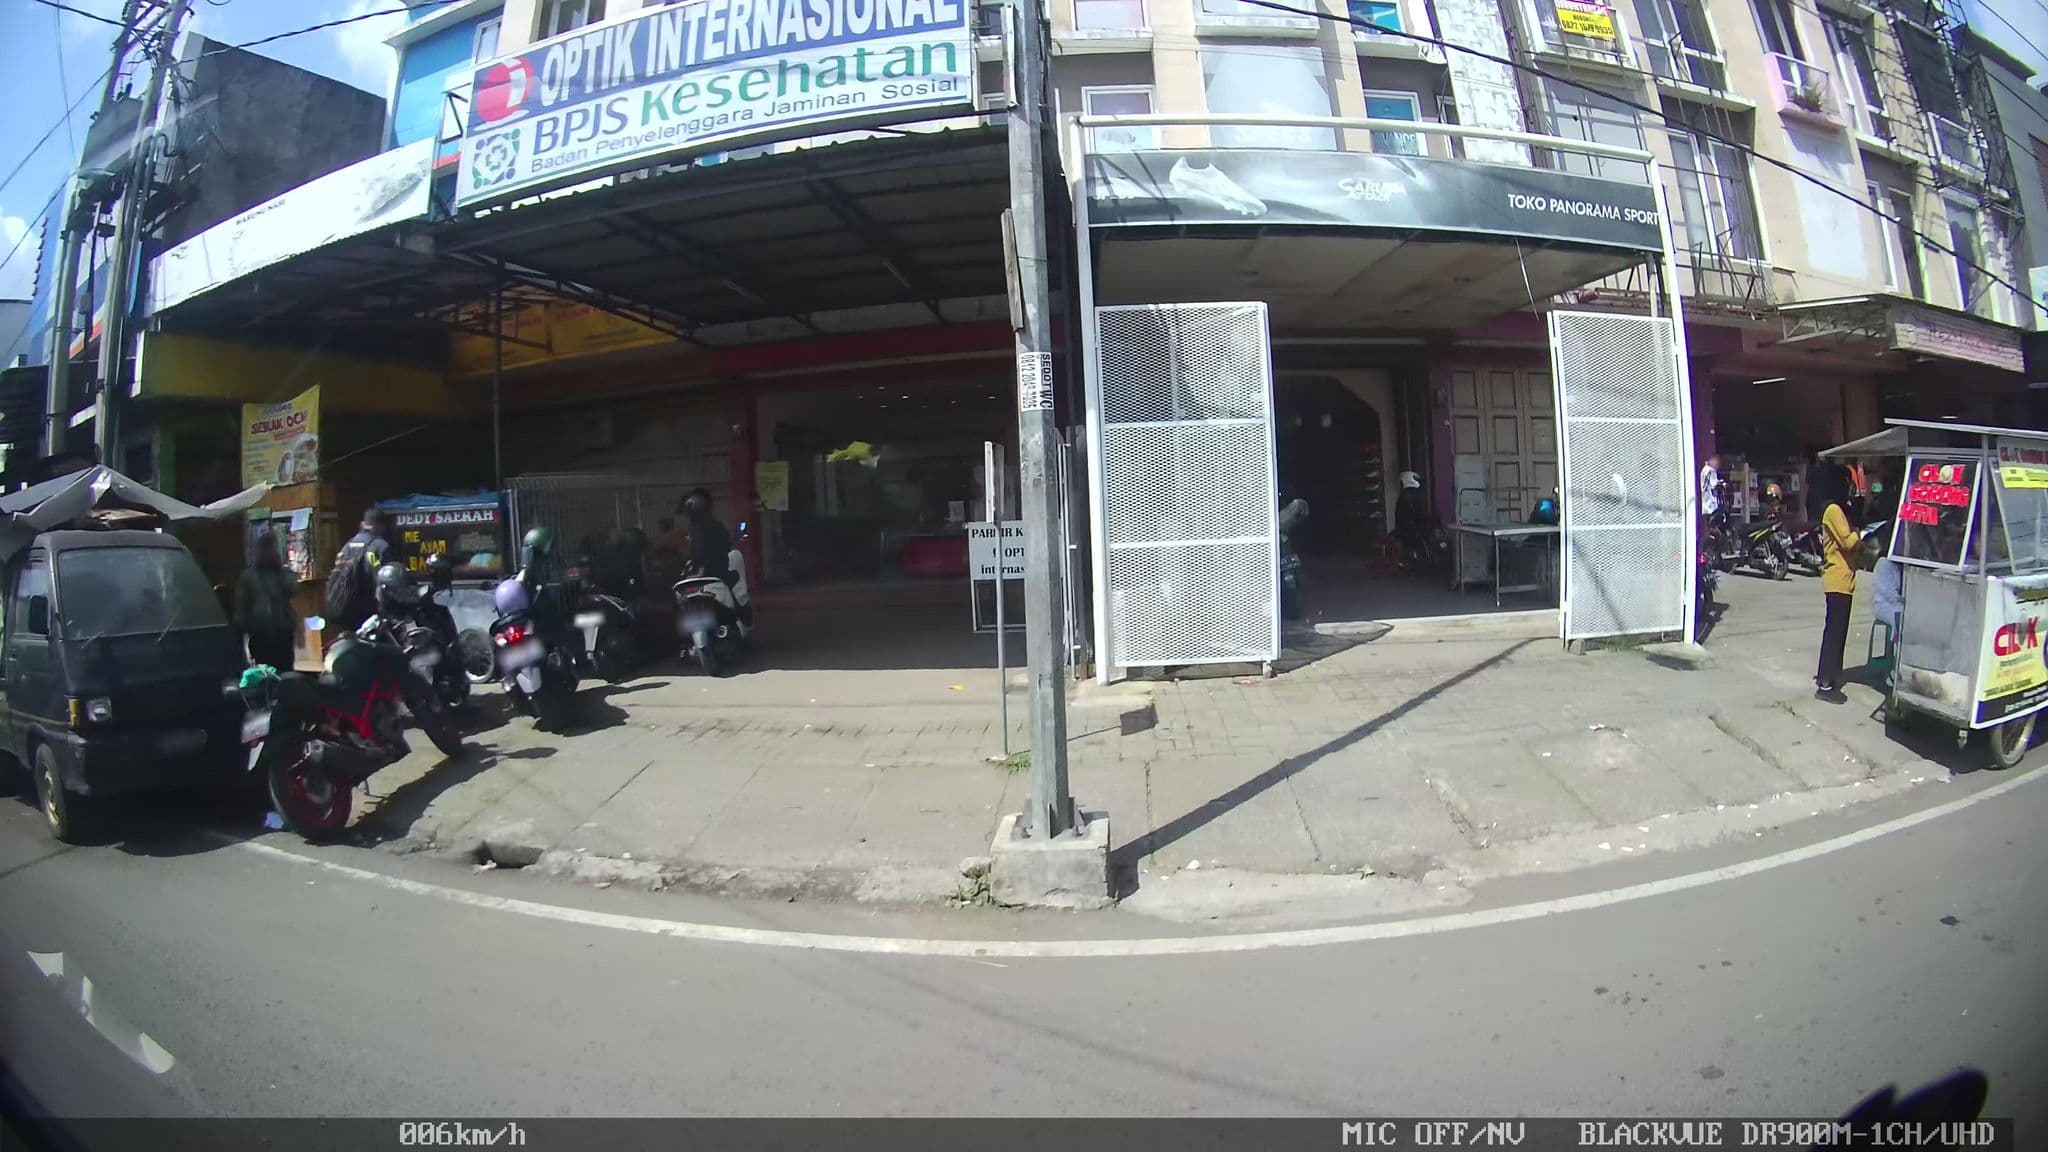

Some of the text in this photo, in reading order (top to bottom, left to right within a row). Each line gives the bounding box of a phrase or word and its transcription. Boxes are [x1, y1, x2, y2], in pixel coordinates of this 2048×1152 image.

[533, 42, 957, 155] BPJS Kesehatan
[541, 19, 640, 107] OPTIK
[531, 76, 958, 173] Badan Penyelenggara Jaminan Sosial
[1508, 194, 1661, 226] TOKO PANORAMA SPORT
[1039, 353, 1053, 408] SEDOT WC
